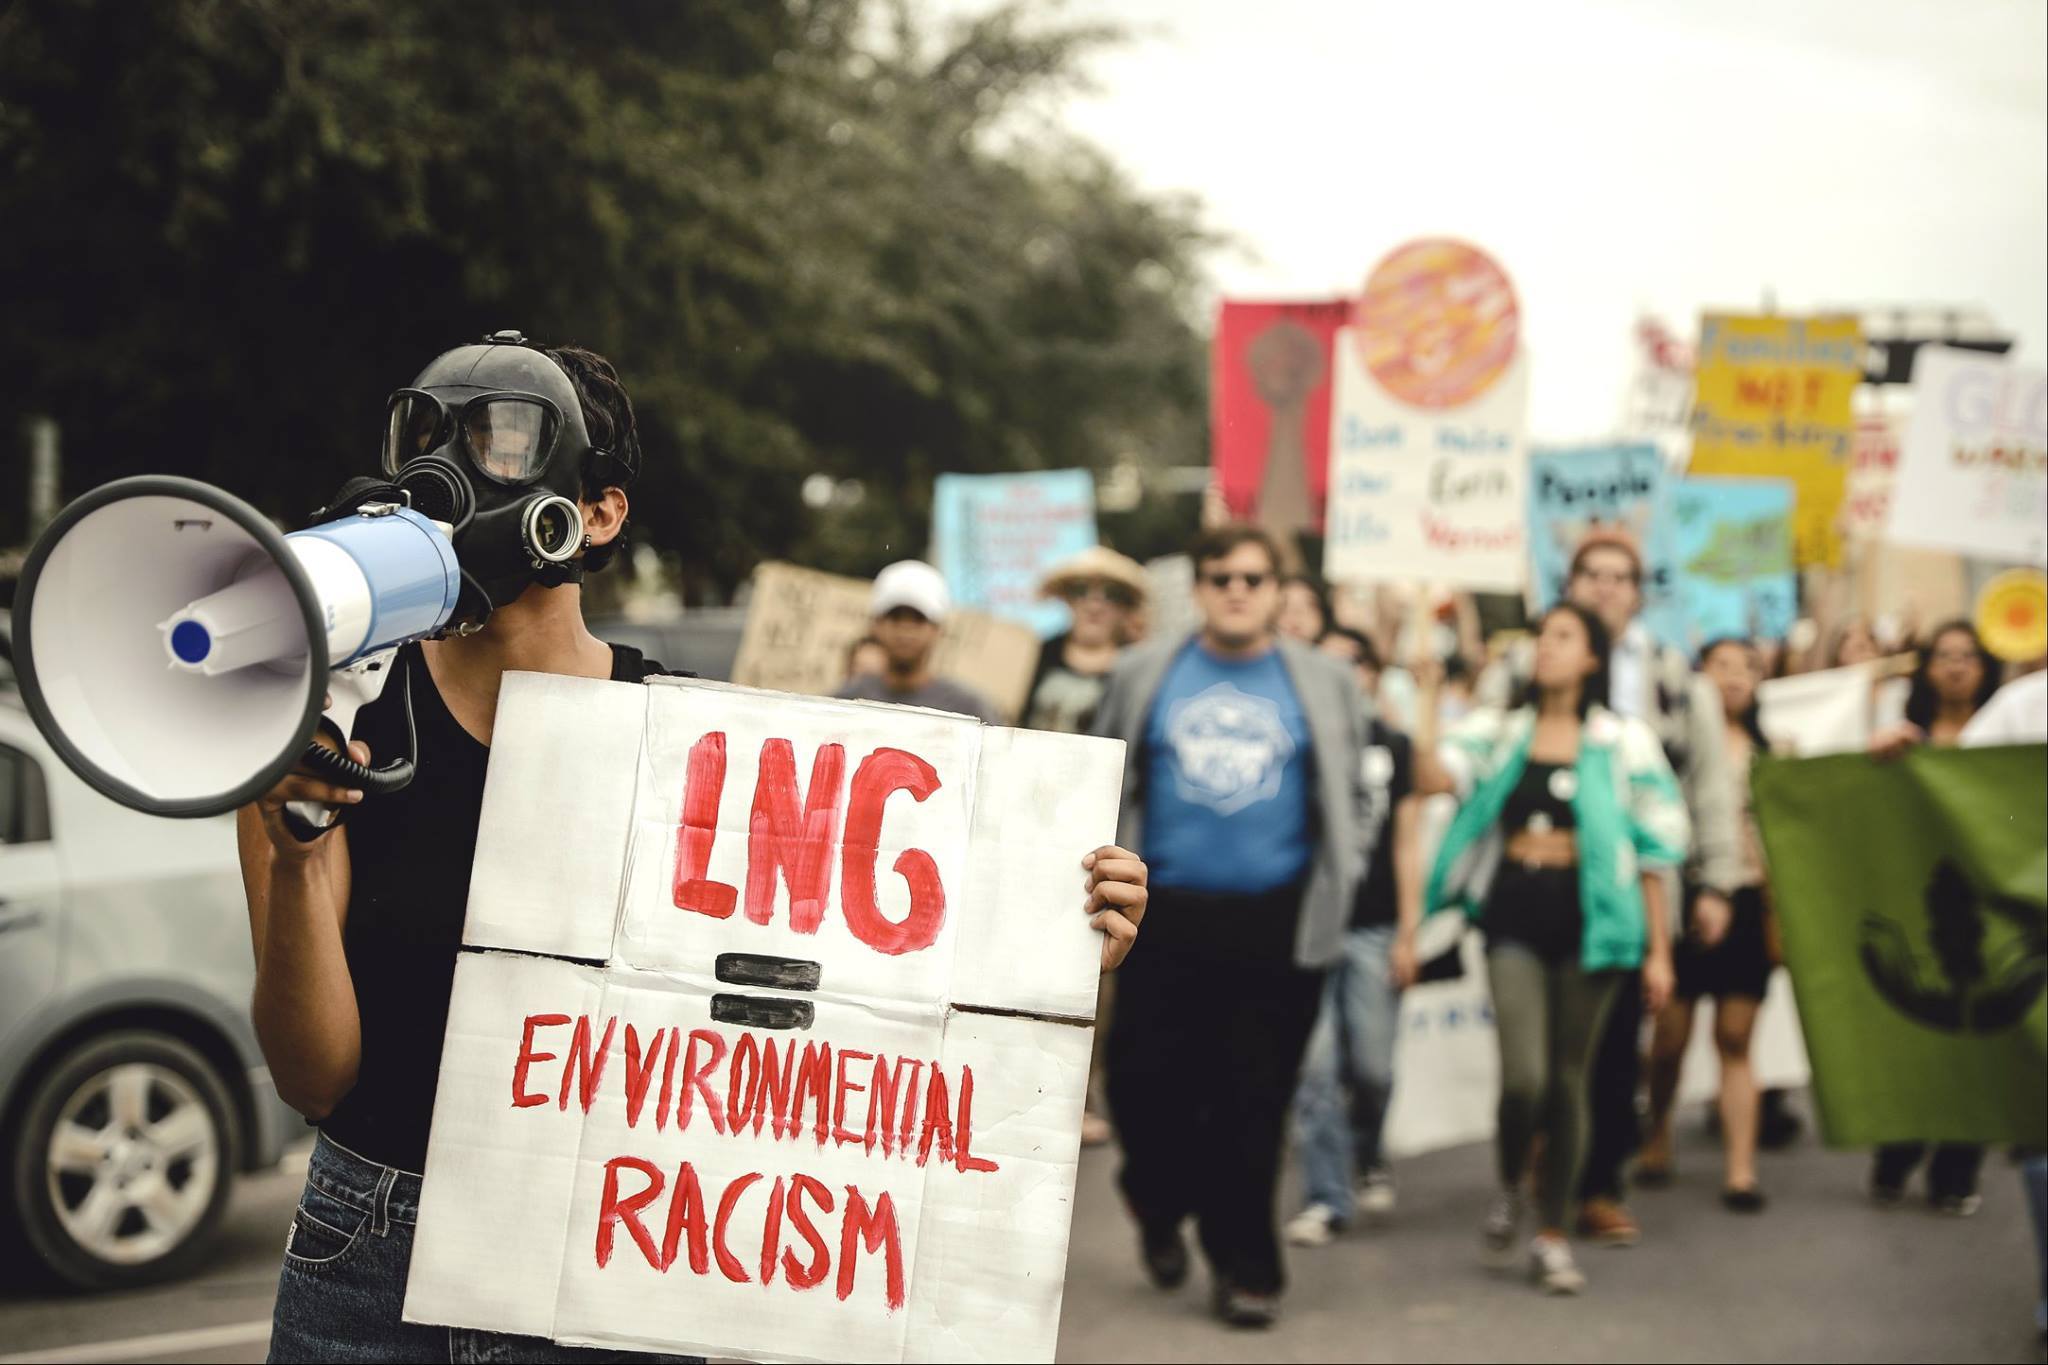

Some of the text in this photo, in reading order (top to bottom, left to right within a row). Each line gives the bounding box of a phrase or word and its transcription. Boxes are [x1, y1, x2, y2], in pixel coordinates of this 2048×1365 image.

[1736, 374, 1823, 411] NOT
[673, 731, 946, 955] LNG
[511, 1013, 1000, 1173] ENVIRONMENTAL
[595, 1154, 906, 1313] RACISM
